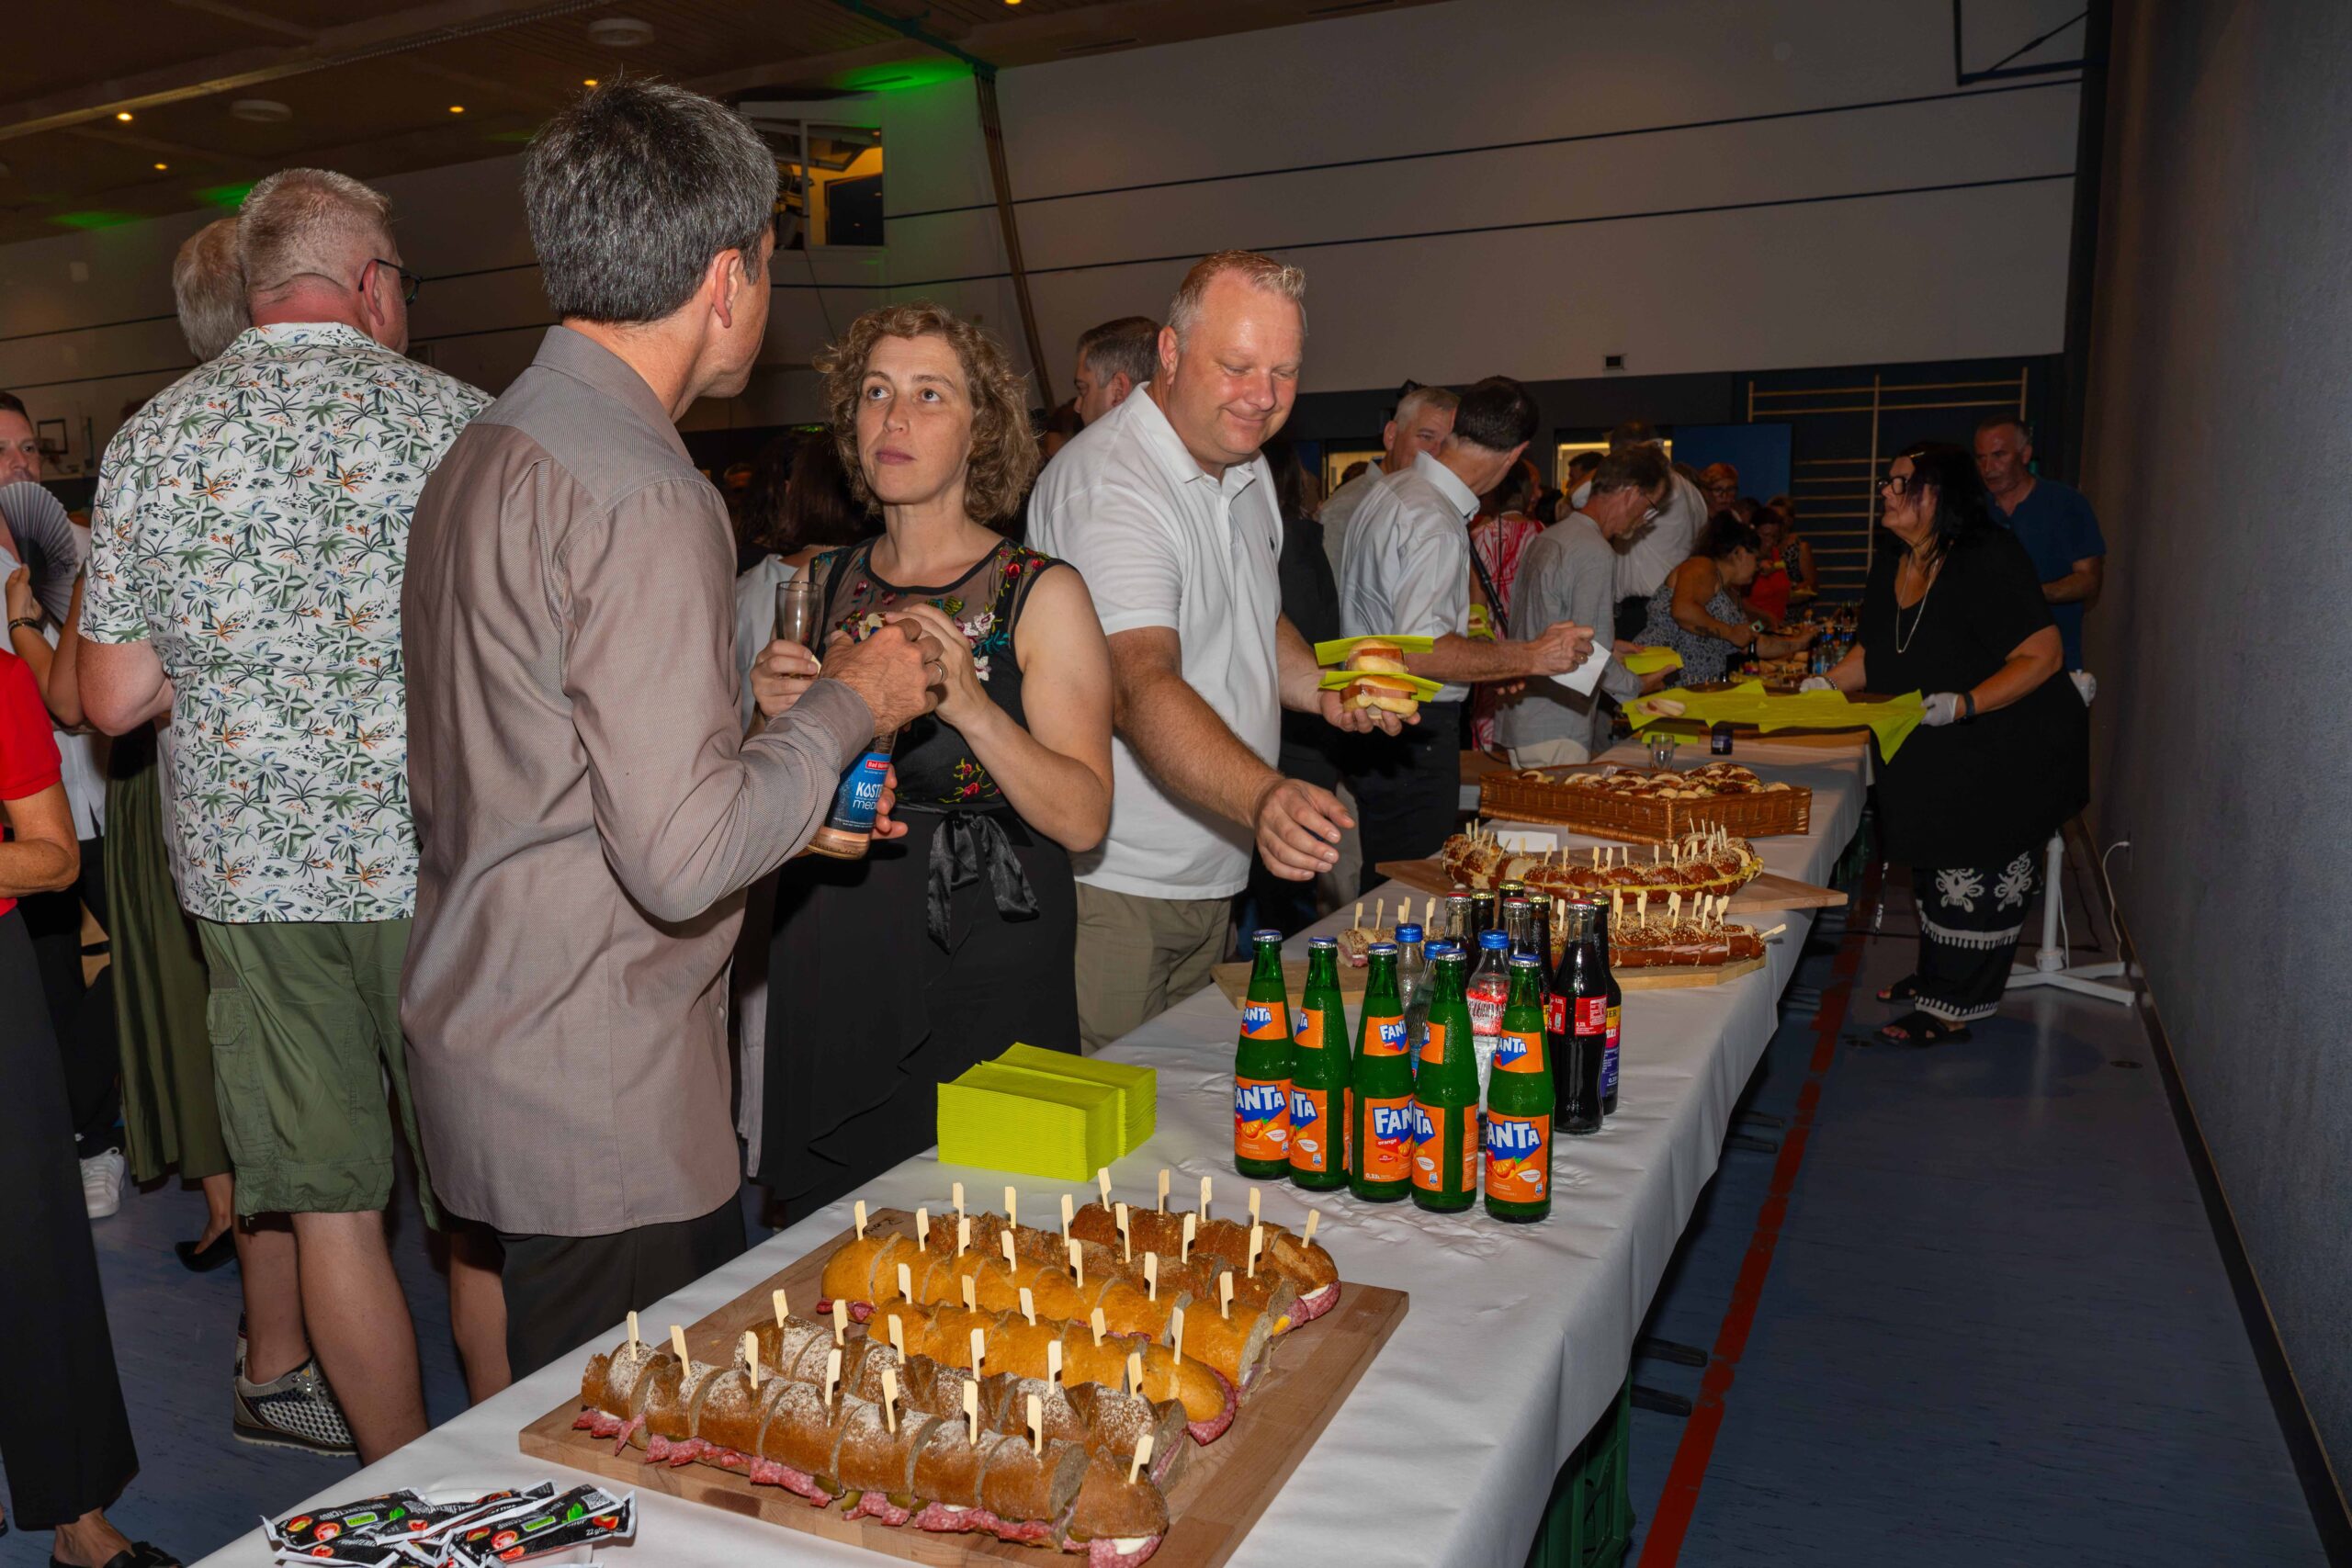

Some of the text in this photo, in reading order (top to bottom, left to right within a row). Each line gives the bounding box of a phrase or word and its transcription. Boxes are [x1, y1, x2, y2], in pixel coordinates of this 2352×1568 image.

[855, 781, 883, 798] KOST
[1243, 1007, 1272, 1021] ANTA
[1498, 1036, 1527, 1054] ANTA
[1235, 1086, 1285, 1111] ANTA
[1374, 1100, 1413, 1134] FAN
[1487, 1122, 1541, 1149] ANTA
